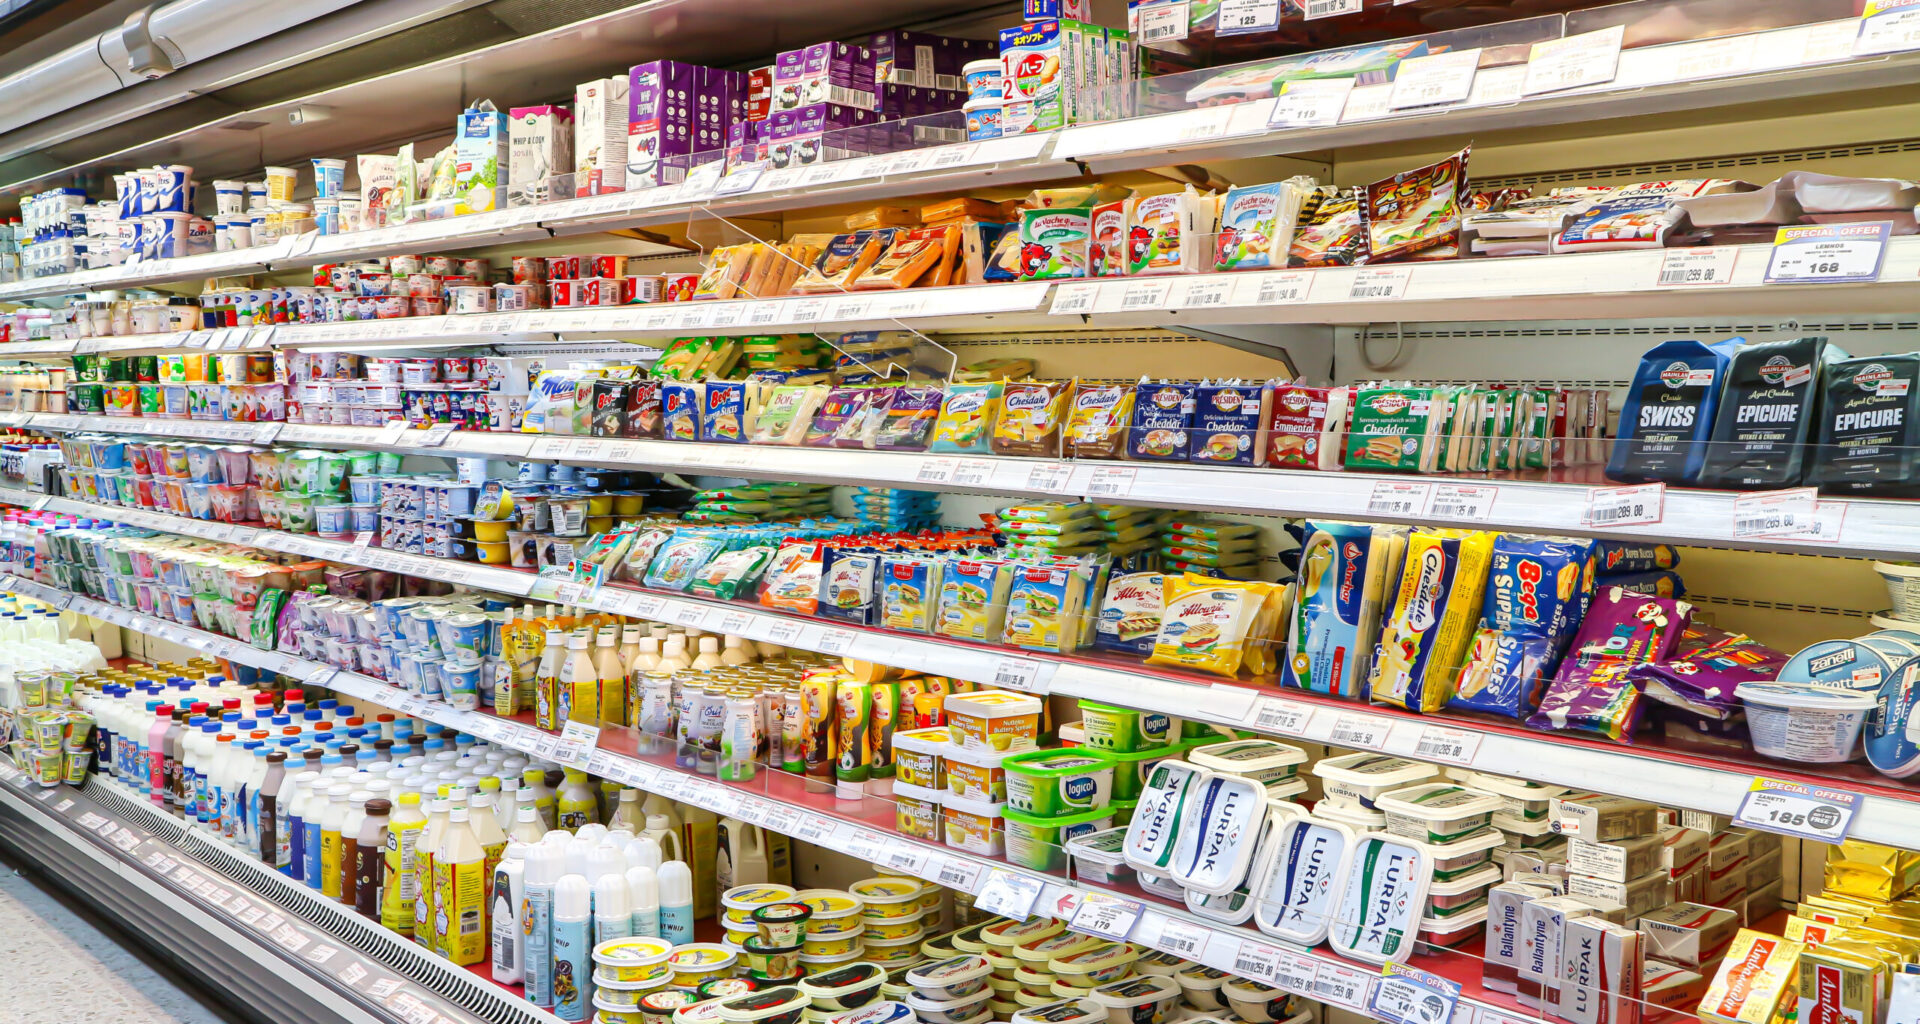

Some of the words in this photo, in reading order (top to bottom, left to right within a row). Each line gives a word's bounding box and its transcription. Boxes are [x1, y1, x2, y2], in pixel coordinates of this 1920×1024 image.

[1239, 16, 1256, 26] 125
[1013, 32, 1044, 46] ネオソフト
[1002, 55, 1010, 76] 1
[1020, 59, 1045, 76] ハーフ
[1003, 79, 1014, 100] 2
[1374, 159, 1456, 207] スモーク
[1618, 186, 1679, 197] DODONI
[1785, 228, 1836, 239] SPECIAL
[1840, 225, 1881, 236] OFFER
[1687, 268, 1714, 282] 299.00
[1809, 262, 1839, 274] 168
[1369, 286, 1393, 297] 214.00
[1662, 371, 1689, 379] MAINLAN
[1855, 373, 1892, 382] MAINLAND
[1009, 395, 1046, 407] Chesdale
[1081, 394, 1117, 406] Chesdale
[1211, 393, 1245, 405] PRÉSIDENT
[1639, 405, 1696, 427] SWISS
[1736, 404, 1798, 423] EPICURE
[1834, 408, 1903, 432] EPICURE
[1145, 418, 1181, 429] Cheddar
[1206, 421, 1244, 432] Cheddar
[1274, 420, 1315, 433] Emmental
[1363, 424, 1409, 435] Cheddar
[1607, 547, 1624, 568] Bega
[1340, 560, 1357, 603] Anchor
[1415, 553, 1438, 624] Chesdale
[1403, 576, 1415, 611] Calcium
[1517, 558, 1542, 622] Bega
[1179, 603, 1224, 618] Allowrie
[1548, 604, 1563, 636] SLICES
[1486, 634, 1518, 696] SLICES
[1811, 648, 1855, 670] zanetti
[1146, 715, 1168, 732] logicol
[1259, 771, 1282, 780] LURPAK
[1069, 780, 1094, 795] logicol
[1329, 787, 1358, 799] LURPAK
[1762, 780, 1810, 796] SPECIAL
[1814, 790, 1854, 803] OFFER
[1757, 794, 1786, 803] ZANETTI
[1143, 777, 1181, 853] LURPAK
[1560, 804, 1586, 815] LURPAK
[1459, 820, 1479, 829] LURPAK
[1769, 810, 1805, 826] 185
[1203, 792, 1239, 872] LURPAK
[1461, 856, 1482, 865] LURPAK
[1291, 838, 1327, 921] LURPAK
[1368, 855, 1403, 943] LURPAK
[1665, 907, 1700, 922] LURPAK
[1094, 919, 1111, 930] 179
[1500, 906, 1516, 958] Ballantyne
[1651, 922, 1685, 934] LURPAK
[1531, 920, 1547, 974] Ballantyne
[1390, 964, 1423, 983] SPECIAL
[1577, 937, 1592, 1012] LURPAK
[1724, 942, 1769, 1013] Ambasador
[1662, 992, 1688, 1004] LURPAK
